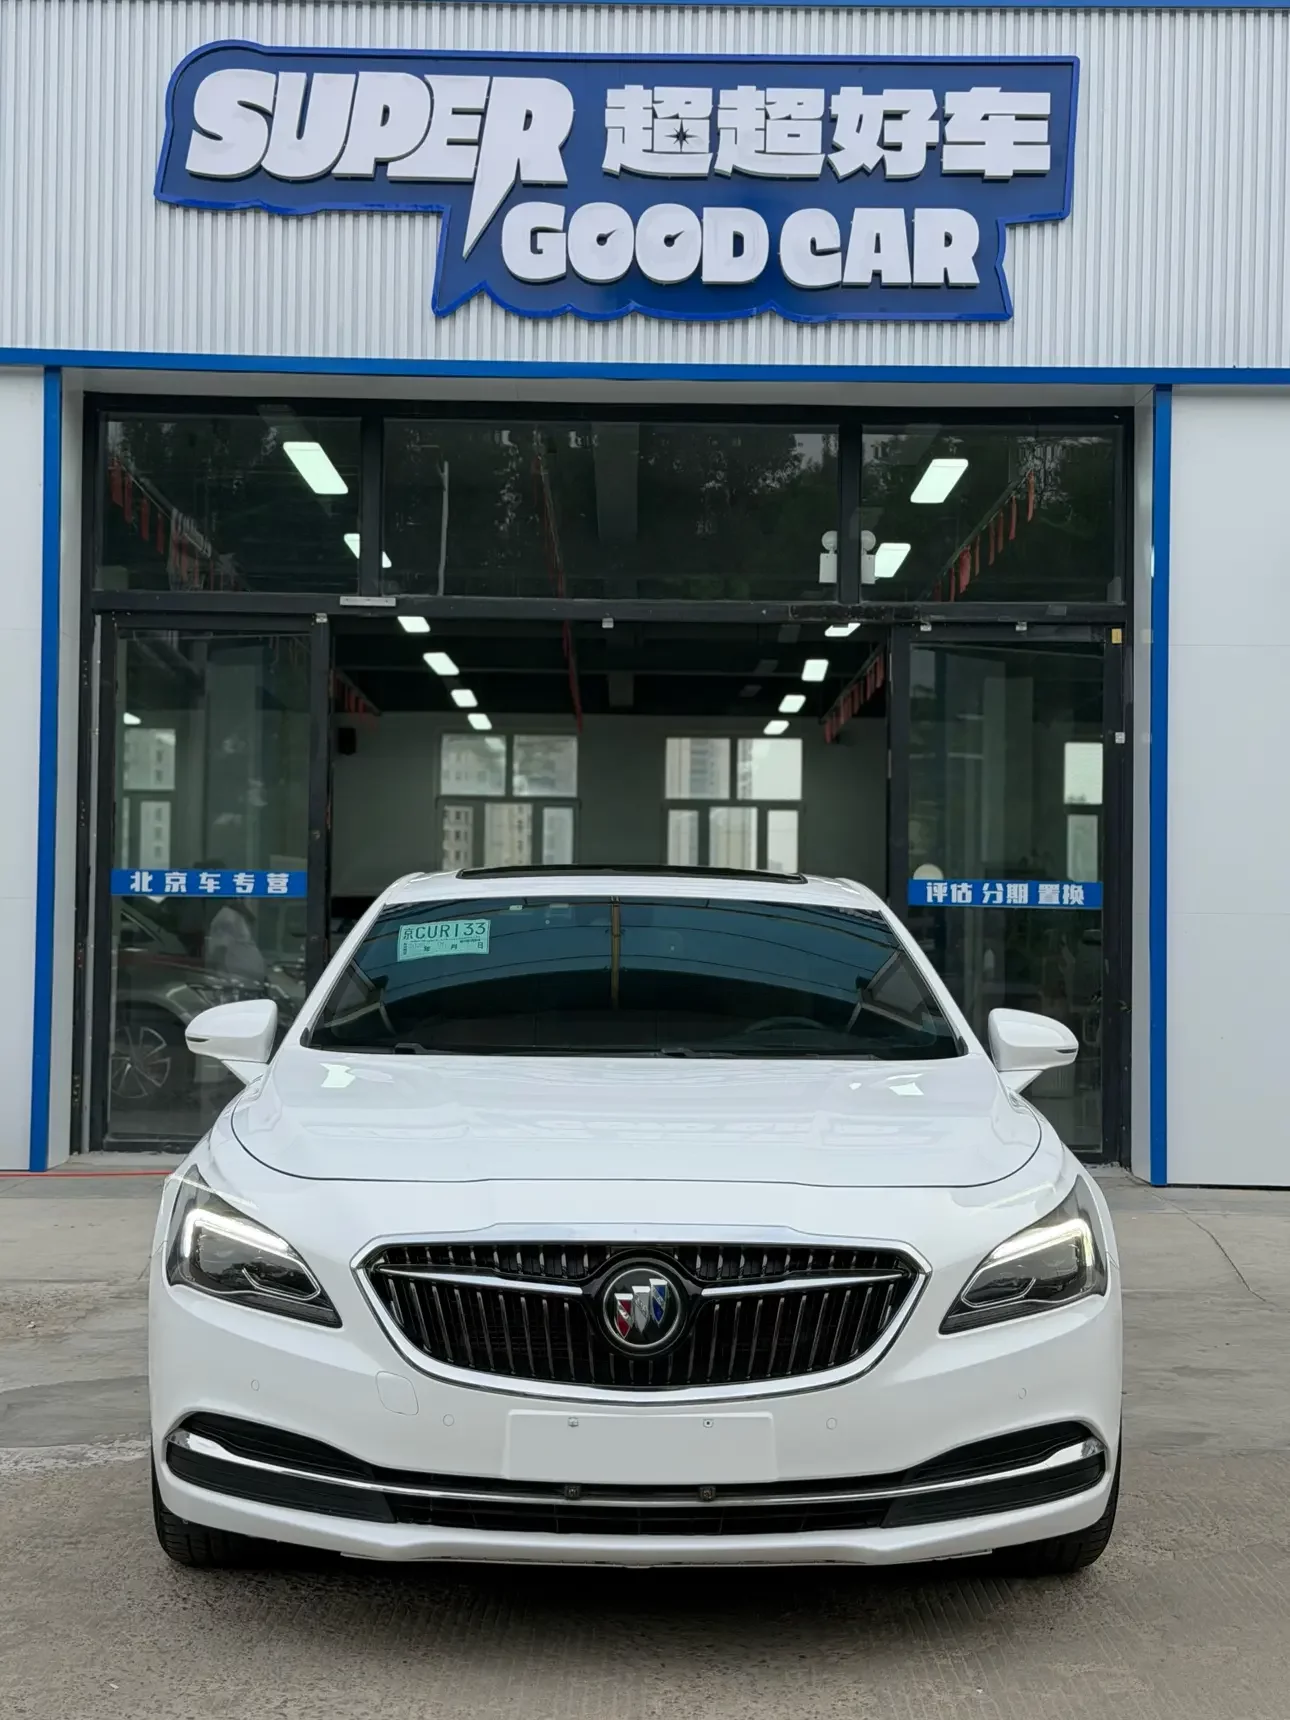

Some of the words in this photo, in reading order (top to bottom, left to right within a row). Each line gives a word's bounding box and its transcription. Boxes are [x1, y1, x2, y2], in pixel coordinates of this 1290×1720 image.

[185, 68, 574, 259] SUPER
[602, 84, 1051, 180] 超超好车
[501, 201, 769, 284] GOOD
[779, 207, 980, 289] CAR
[130, 871, 290, 894] 北京车专营
